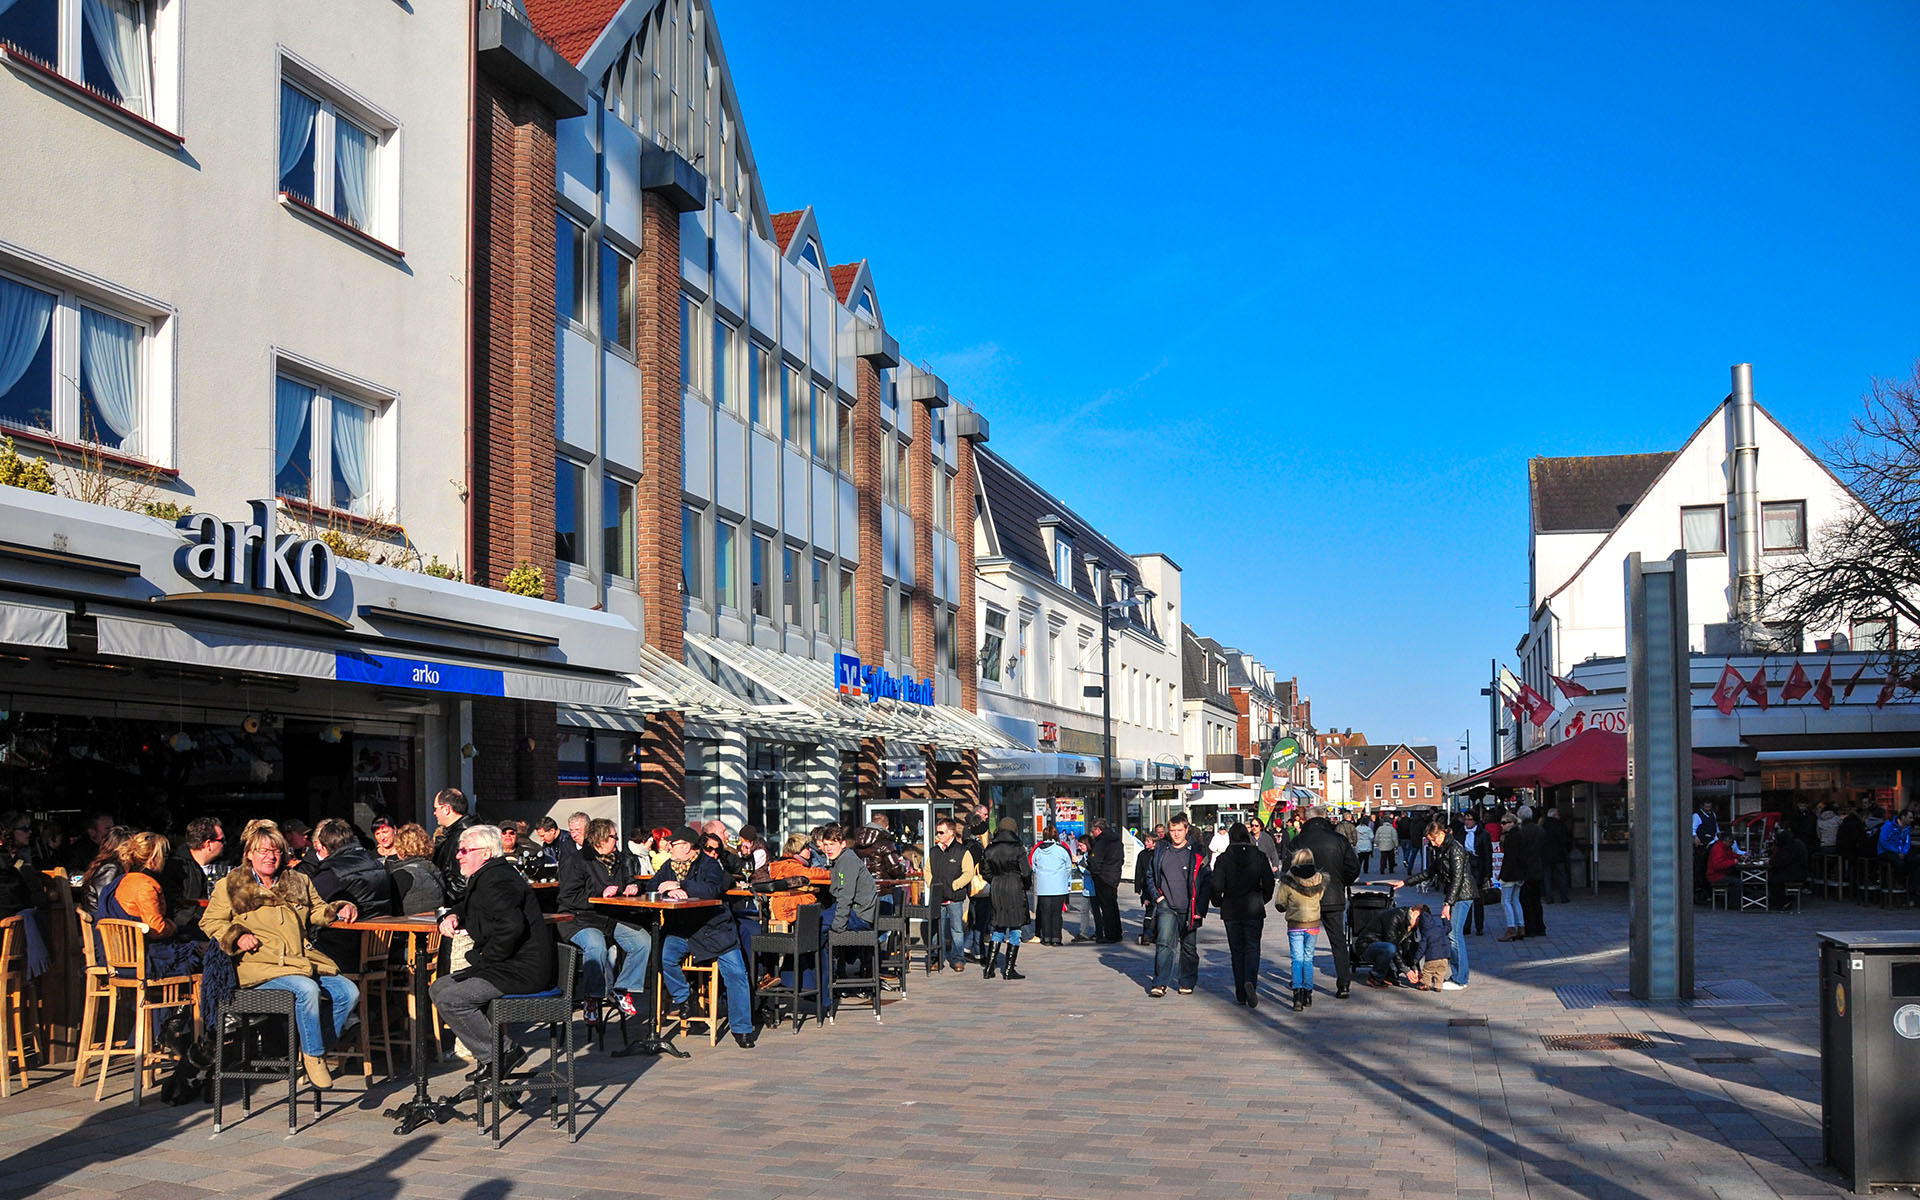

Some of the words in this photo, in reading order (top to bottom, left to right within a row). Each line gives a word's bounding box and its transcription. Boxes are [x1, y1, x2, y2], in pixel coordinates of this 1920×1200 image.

[175, 500, 337, 601] arko
[412, 664, 440, 684] arko
[862, 665, 901, 703] Sylter
[903, 675, 935, 706] Bank
